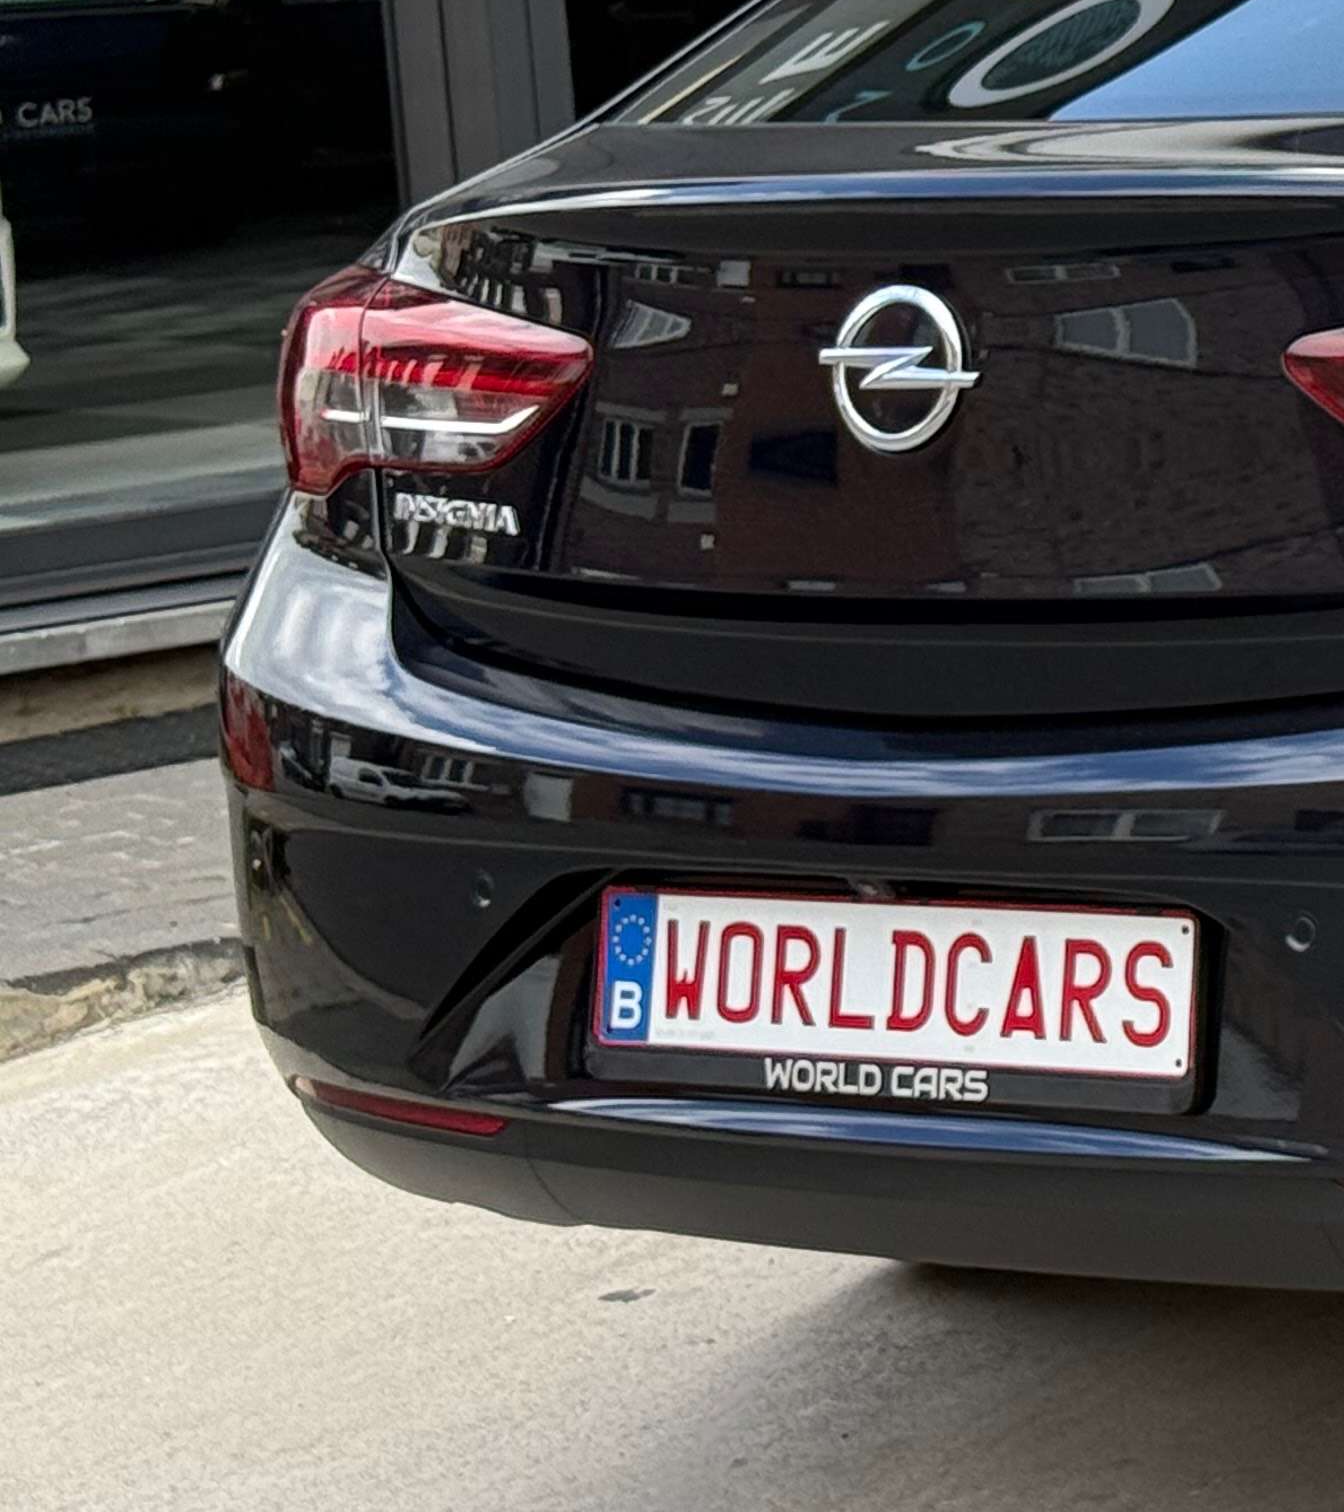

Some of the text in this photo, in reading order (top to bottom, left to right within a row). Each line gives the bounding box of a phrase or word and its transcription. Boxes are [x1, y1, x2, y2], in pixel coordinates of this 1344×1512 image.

[17, 96, 94, 128] CARS
[610, 980, 644, 1030] B
[664, 918, 1175, 1049] WORLDCARS
[763, 1057, 990, 1103] WORLD CARS
